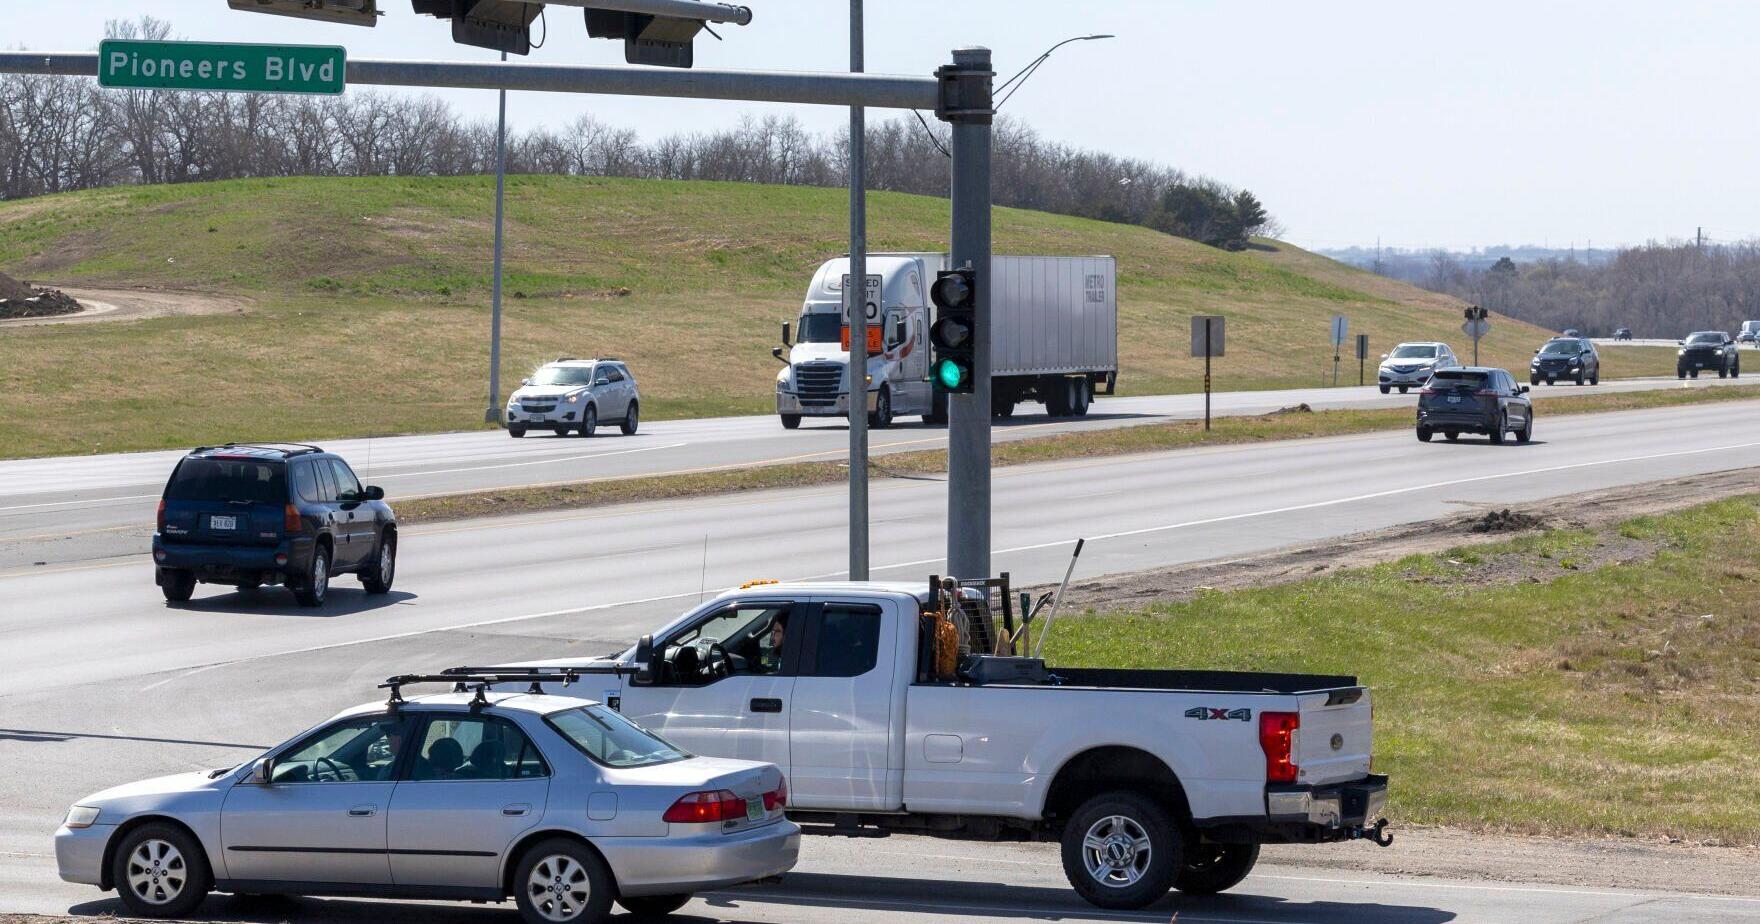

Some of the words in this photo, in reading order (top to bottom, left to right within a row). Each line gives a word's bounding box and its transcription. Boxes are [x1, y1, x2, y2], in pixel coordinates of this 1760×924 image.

[110, 51, 247, 80] Pioneers
[265, 56, 335, 82] Blvd
[845, 279, 879, 287] SED
[1085, 274, 1105, 289] METRO
[846, 301, 878, 319] 0
